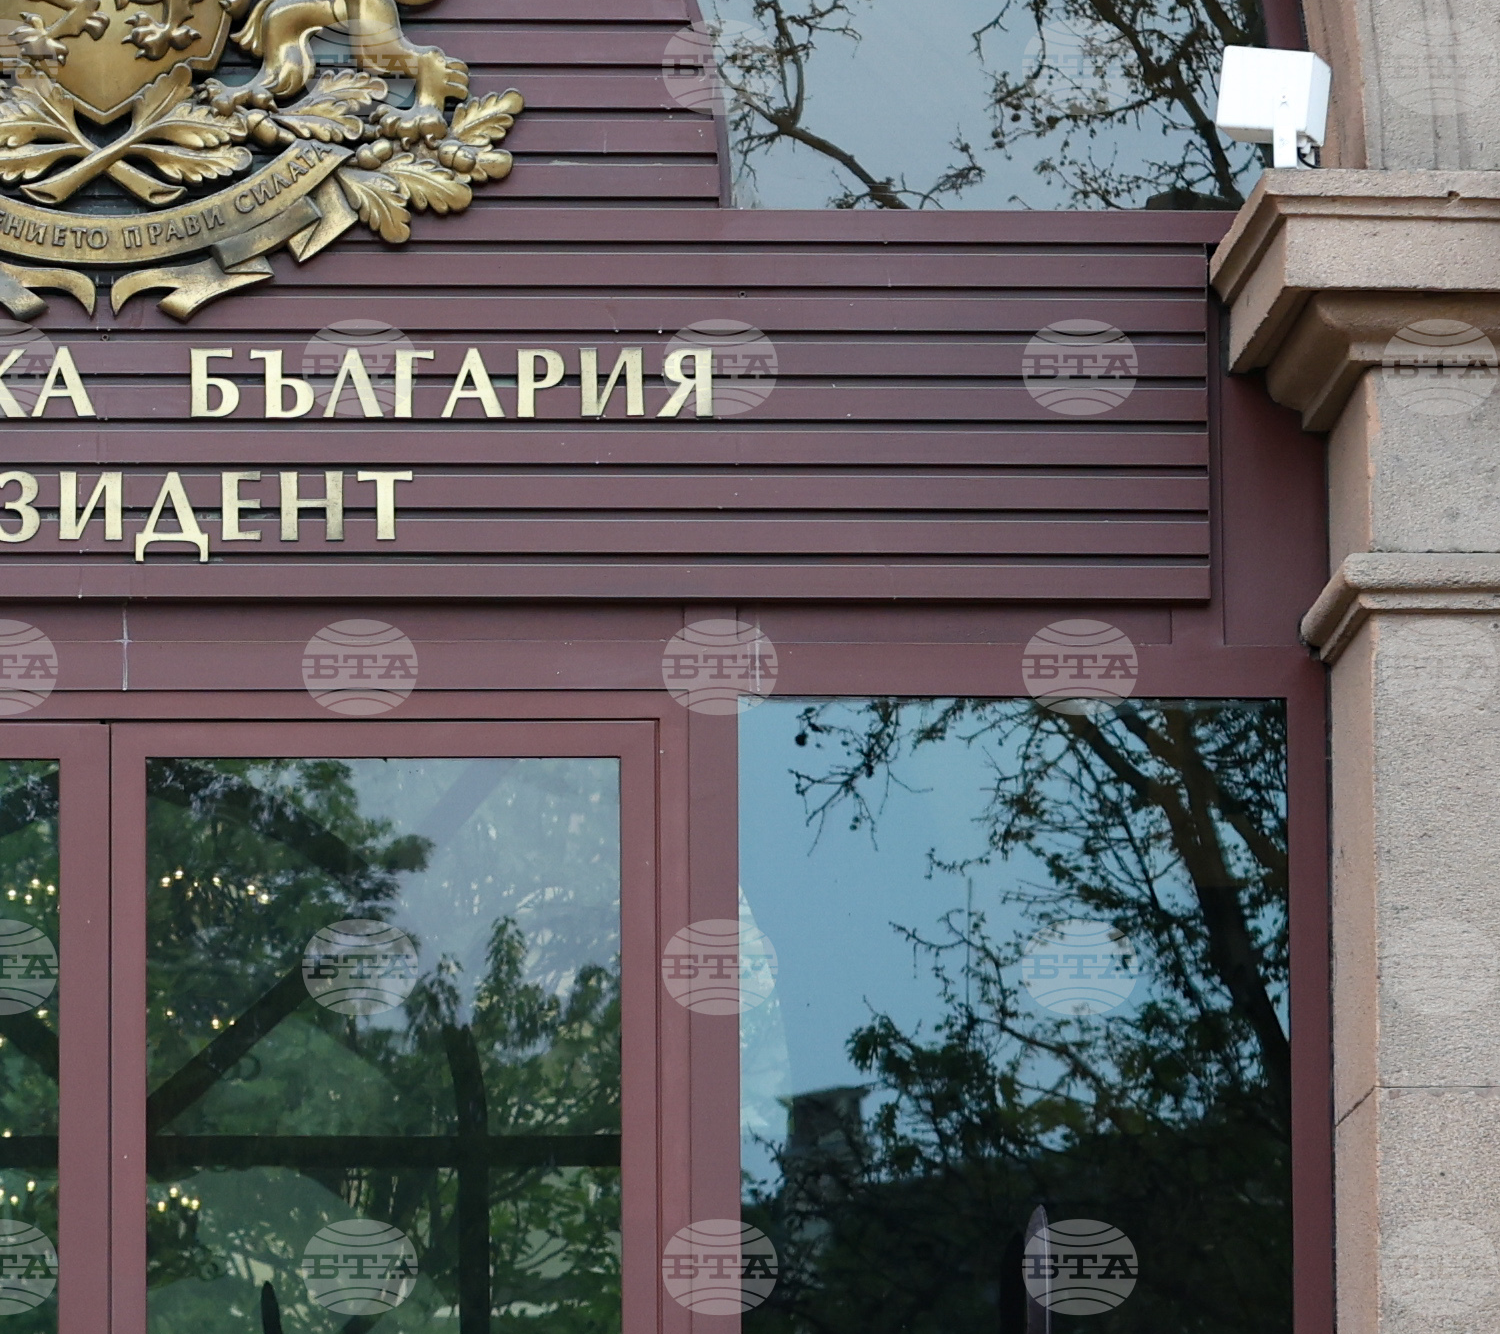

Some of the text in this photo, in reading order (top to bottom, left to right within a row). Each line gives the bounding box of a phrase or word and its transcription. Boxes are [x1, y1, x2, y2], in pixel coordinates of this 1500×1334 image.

[122, 205, 225, 249] ПРАВИ
[234, 142, 333, 214] СИЛАТА
[190, 346, 714, 418] БЪЛГАРИЯ
